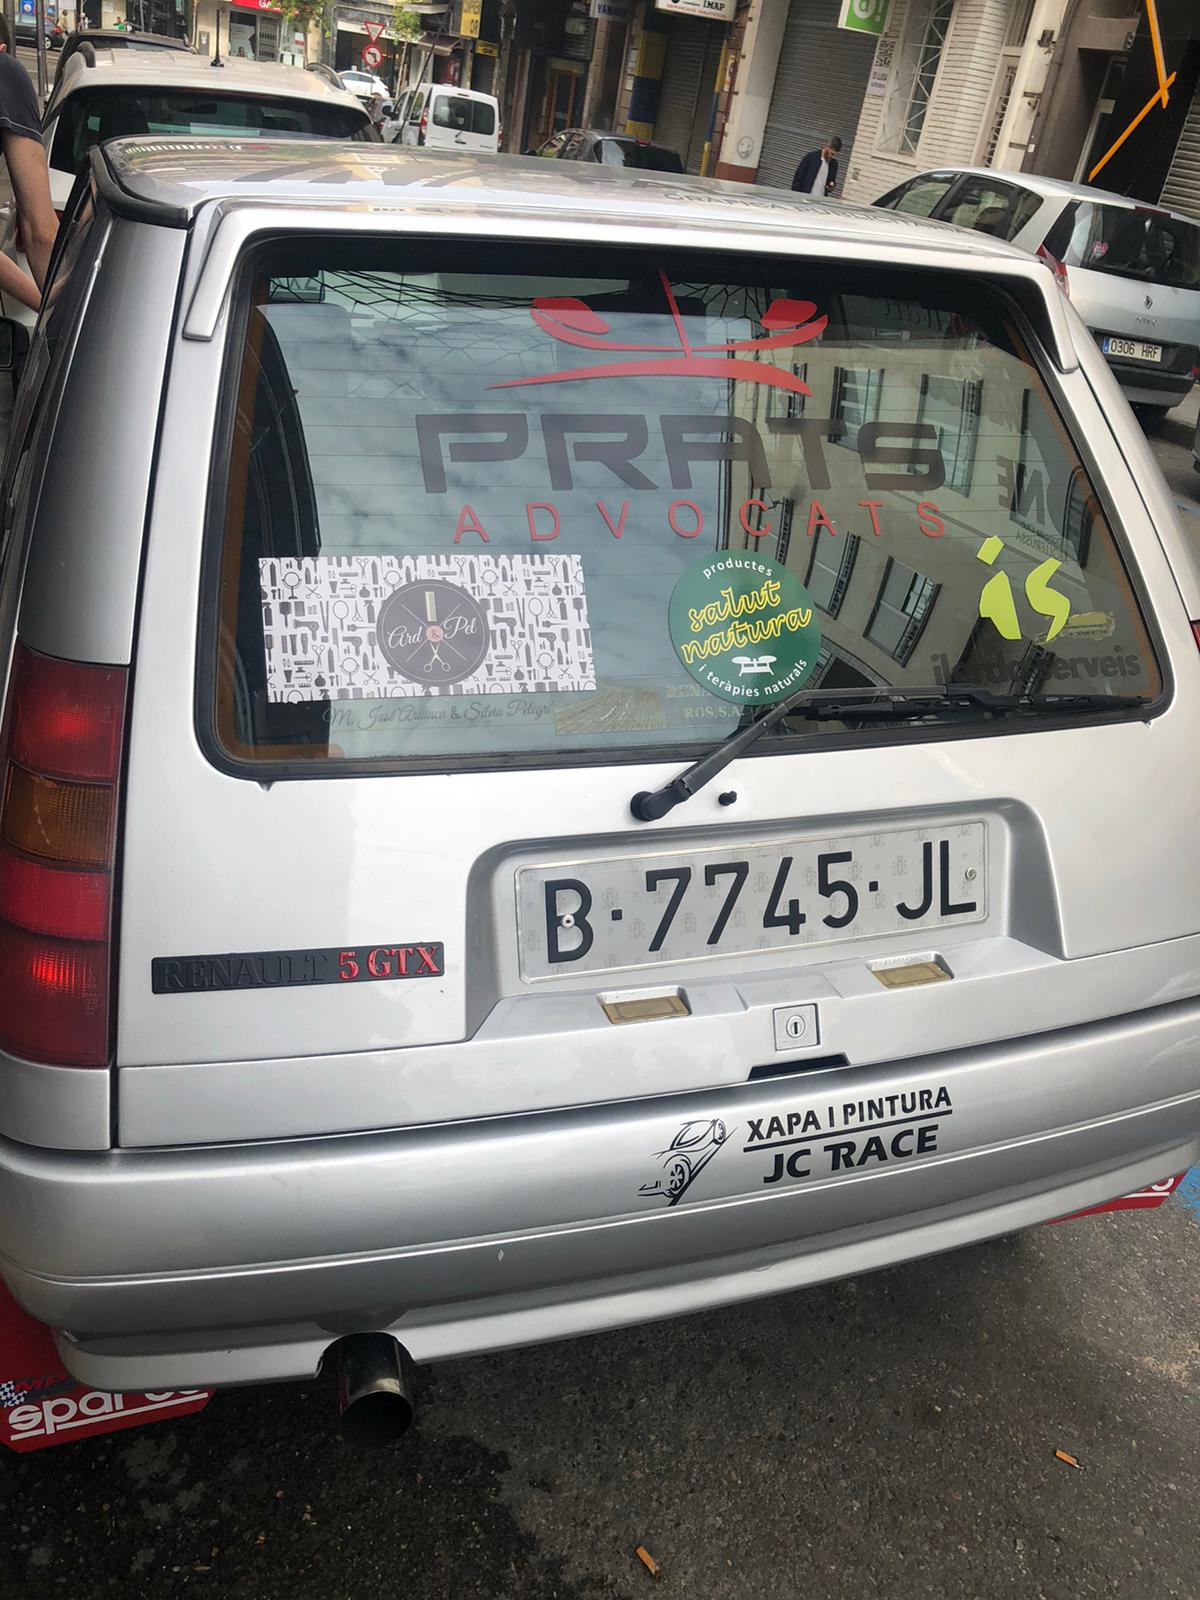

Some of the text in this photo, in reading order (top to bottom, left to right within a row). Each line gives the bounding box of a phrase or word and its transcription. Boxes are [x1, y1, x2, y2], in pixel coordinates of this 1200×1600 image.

[1110, 339, 1160, 359] 0306 HRF
[415, 413, 947, 494] PRATS
[452, 499, 946, 544] ADVOCATS
[703, 557, 773, 579] productes
[688, 579, 782, 632] salut
[386, 625, 423, 649] Ard
[443, 615, 478, 639] Pel
[681, 607, 812, 664] natura
[698, 664, 708, 673] i
[706, 669, 760, 697] teràpies
[765, 657, 808, 695] naturals
[450, 705, 461, 719] &
[157, 945, 441, 990] RENAULT 5 GTX
[746, 1086, 953, 1142] XAPA I PINTURA
[763, 1124, 940, 1183] JC RACE
